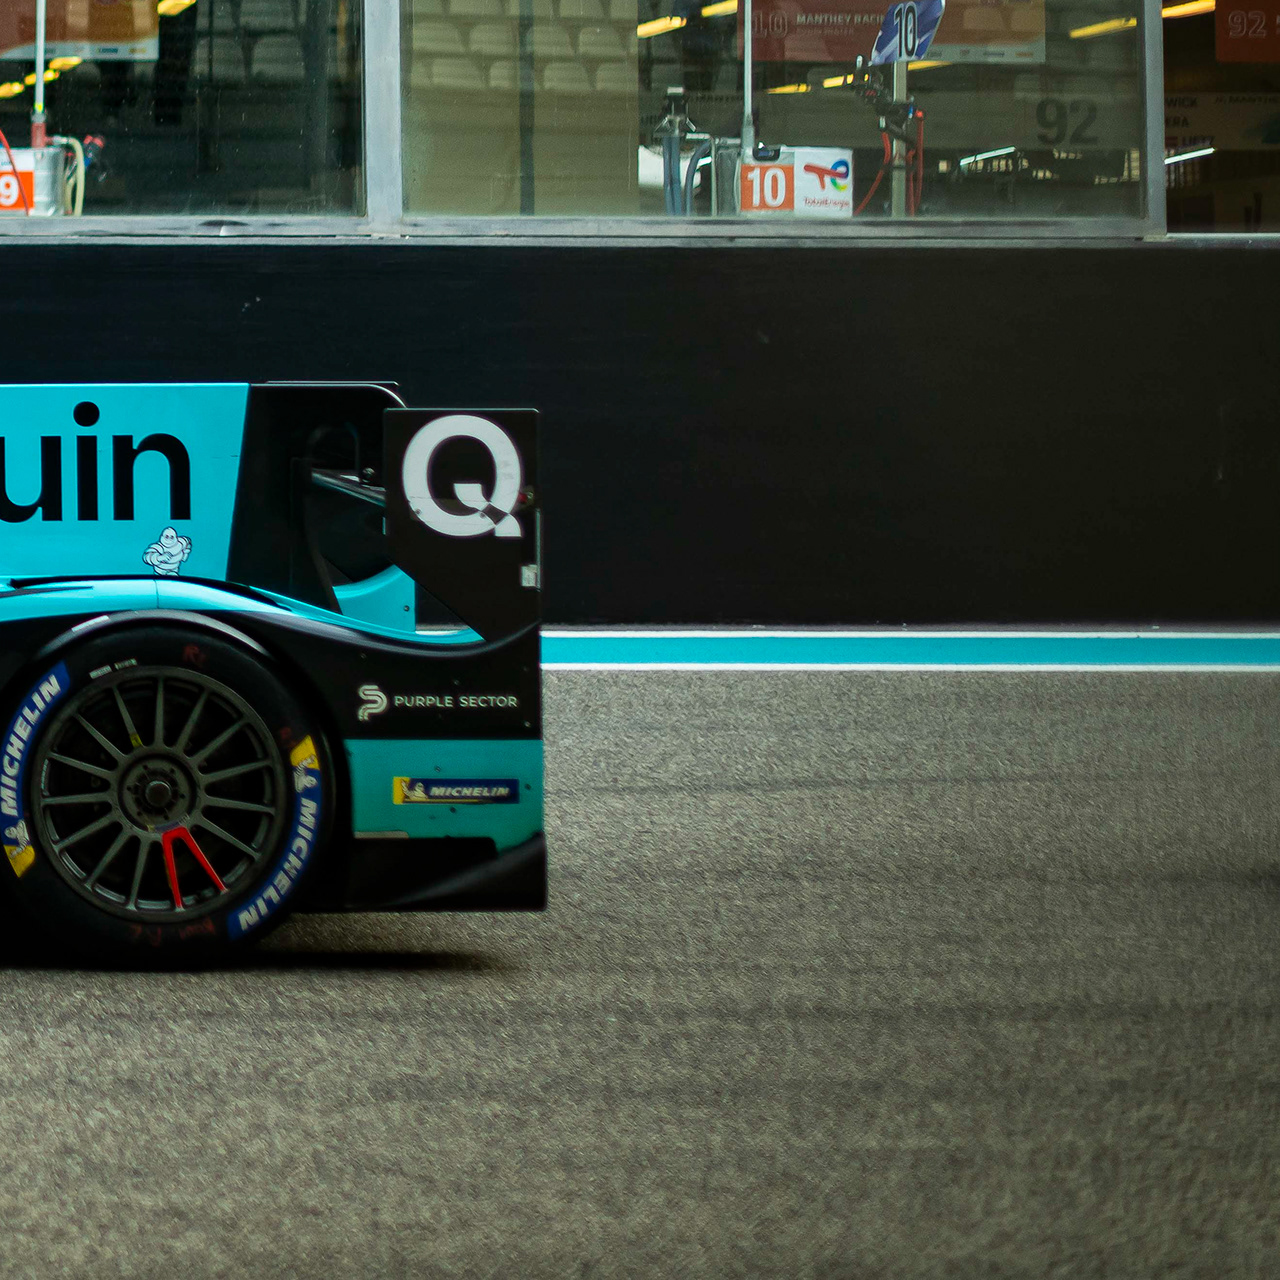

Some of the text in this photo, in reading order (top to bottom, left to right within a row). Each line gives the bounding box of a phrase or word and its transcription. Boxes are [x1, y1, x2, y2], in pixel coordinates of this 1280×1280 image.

[894, 1, 918, 59] 10
[1228, 10, 1267, 38] 92
[1036, 96, 1099, 146] 92
[747, 167, 788, 208] 10
[402, 414, 522, 537] Q
[394, 695, 518, 708] PURPLE SECTOR
[0, 673, 64, 817] MICHELIN
[429, 786, 510, 797] MICHELIN
[237, 797, 319, 932] MICHELIN
